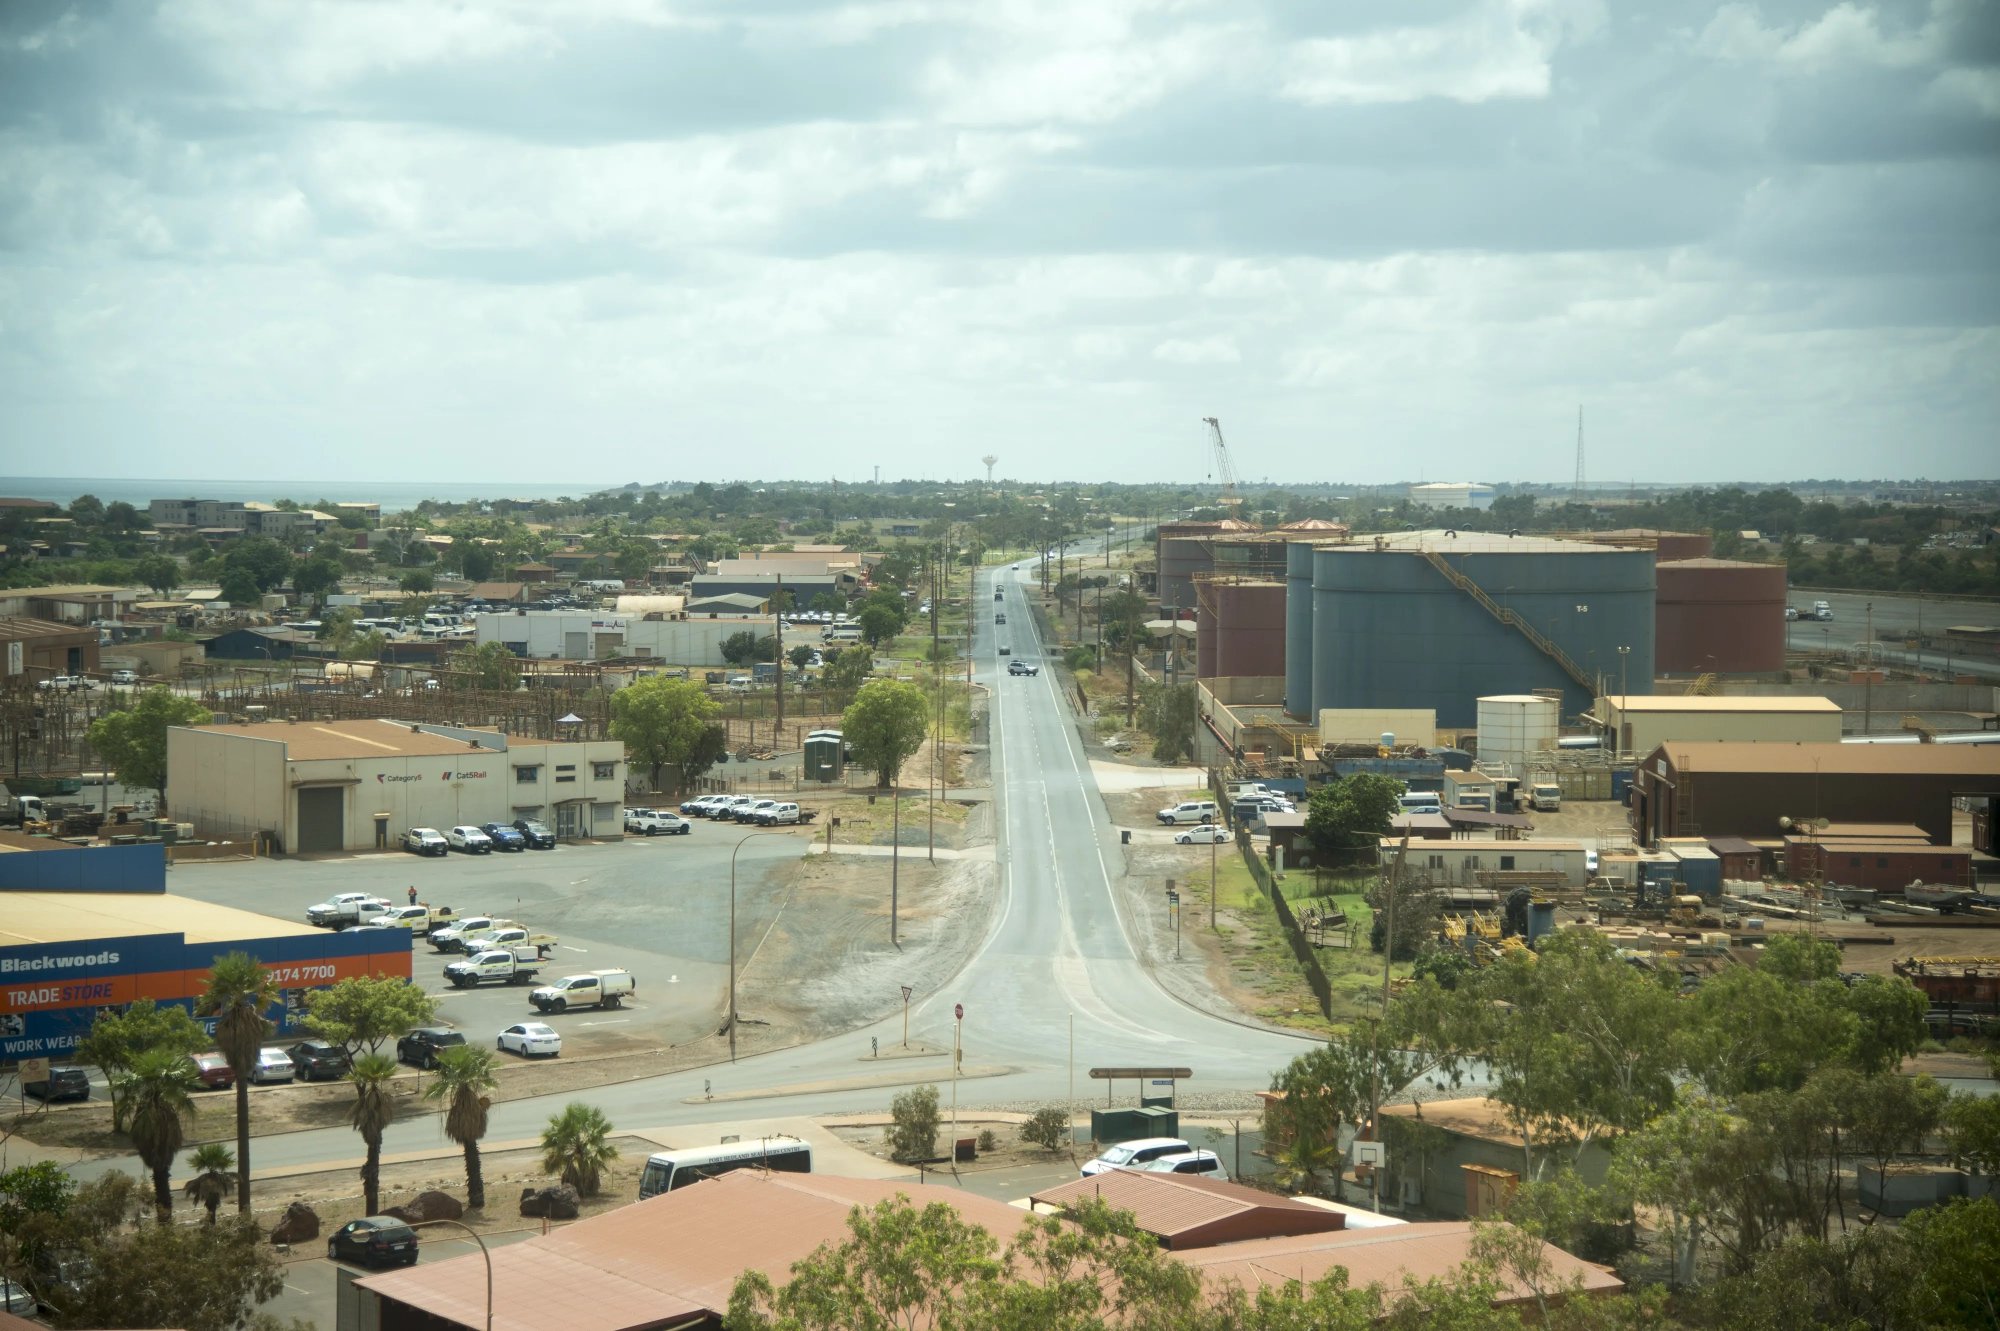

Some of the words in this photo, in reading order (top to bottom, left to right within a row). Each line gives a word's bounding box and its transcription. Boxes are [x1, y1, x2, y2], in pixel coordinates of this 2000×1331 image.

[387, 774, 422, 783] Category5
[456, 770, 487, 780] Cat5Rail
[0, 951, 120, 973] Blackwoods
[302, 964, 336, 980] 7700
[8, 987, 60, 1006] TRADE
[62, 982, 114, 1001] STORE
[4, 1038, 43, 1054] WORK
[46, 1035, 82, 1049] WEAR
